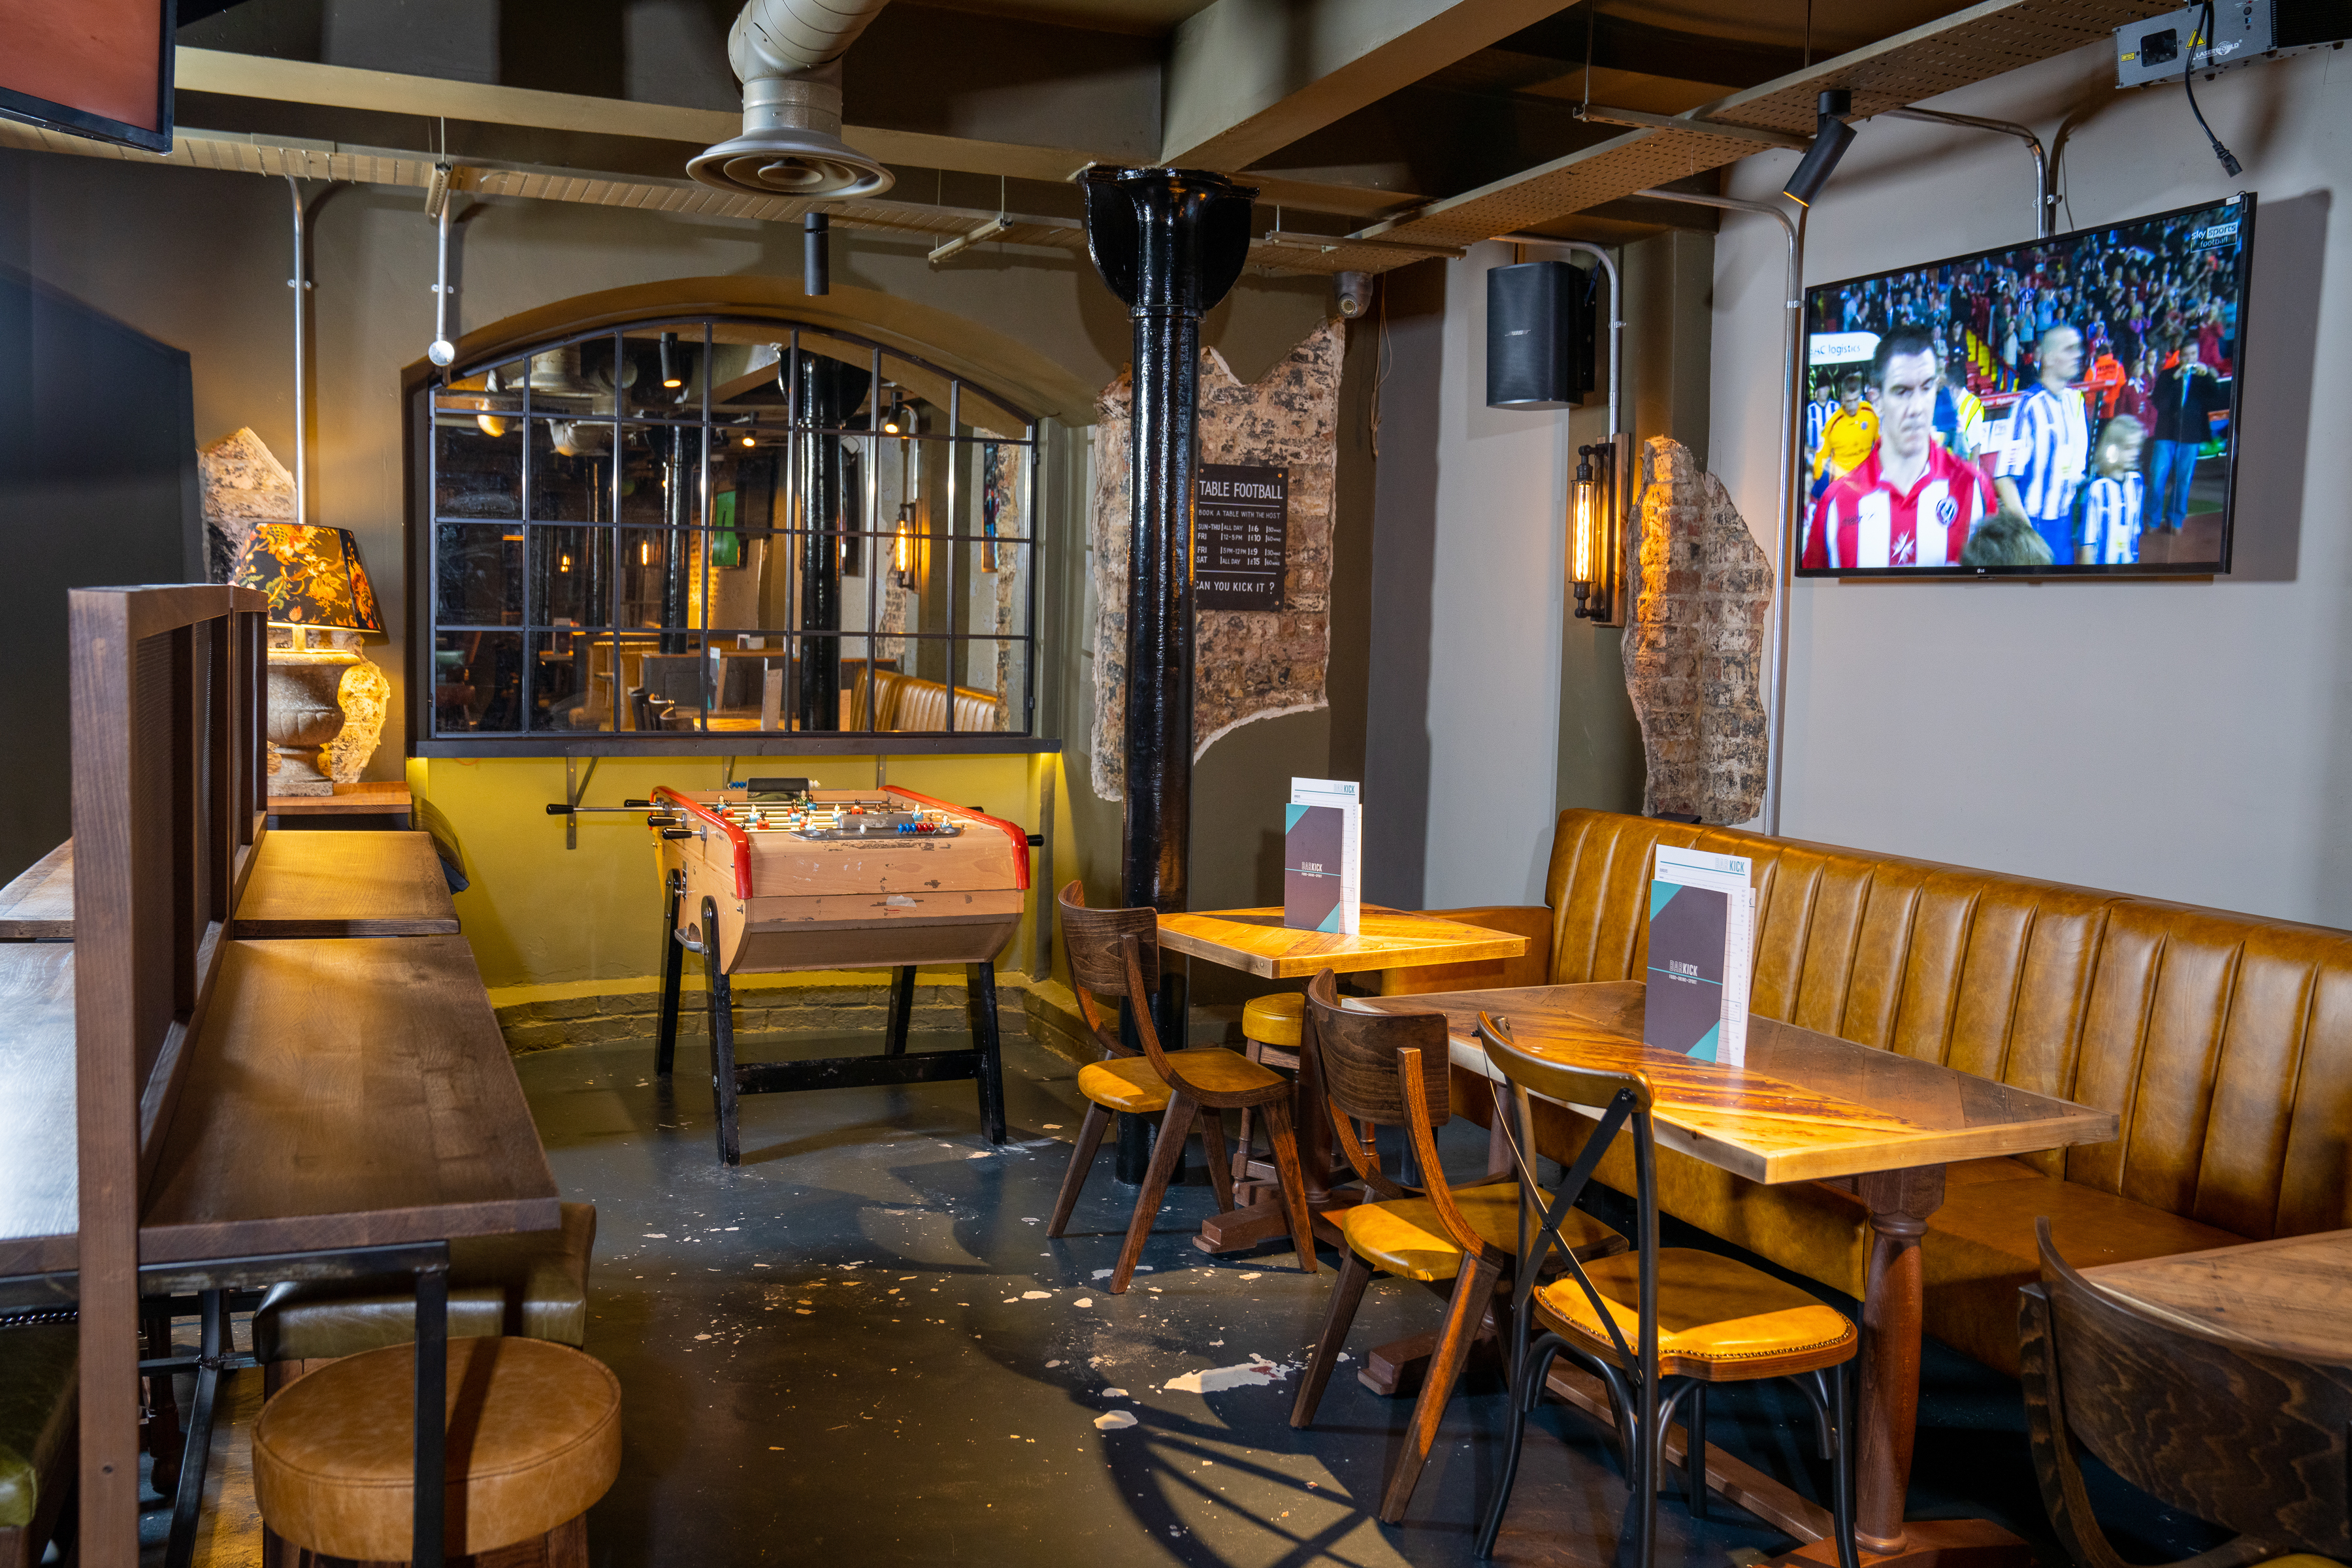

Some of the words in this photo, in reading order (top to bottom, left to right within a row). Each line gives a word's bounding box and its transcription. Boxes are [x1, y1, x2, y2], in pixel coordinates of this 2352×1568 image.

[2191, 229, 2206, 240] sky
[2208, 225, 2236, 237] sports
[2200, 236, 2229, 248] football
[1829, 344, 1861, 356] logistics
[1199, 480, 1230, 497] TABLE
[1233, 482, 1283, 499] FOOTBALL
[1214, 581, 1230, 591] YOU
[1233, 582, 1253, 592] KICK
[1256, 583, 1265, 593] IT
[1269, 581, 1275, 595] ?
